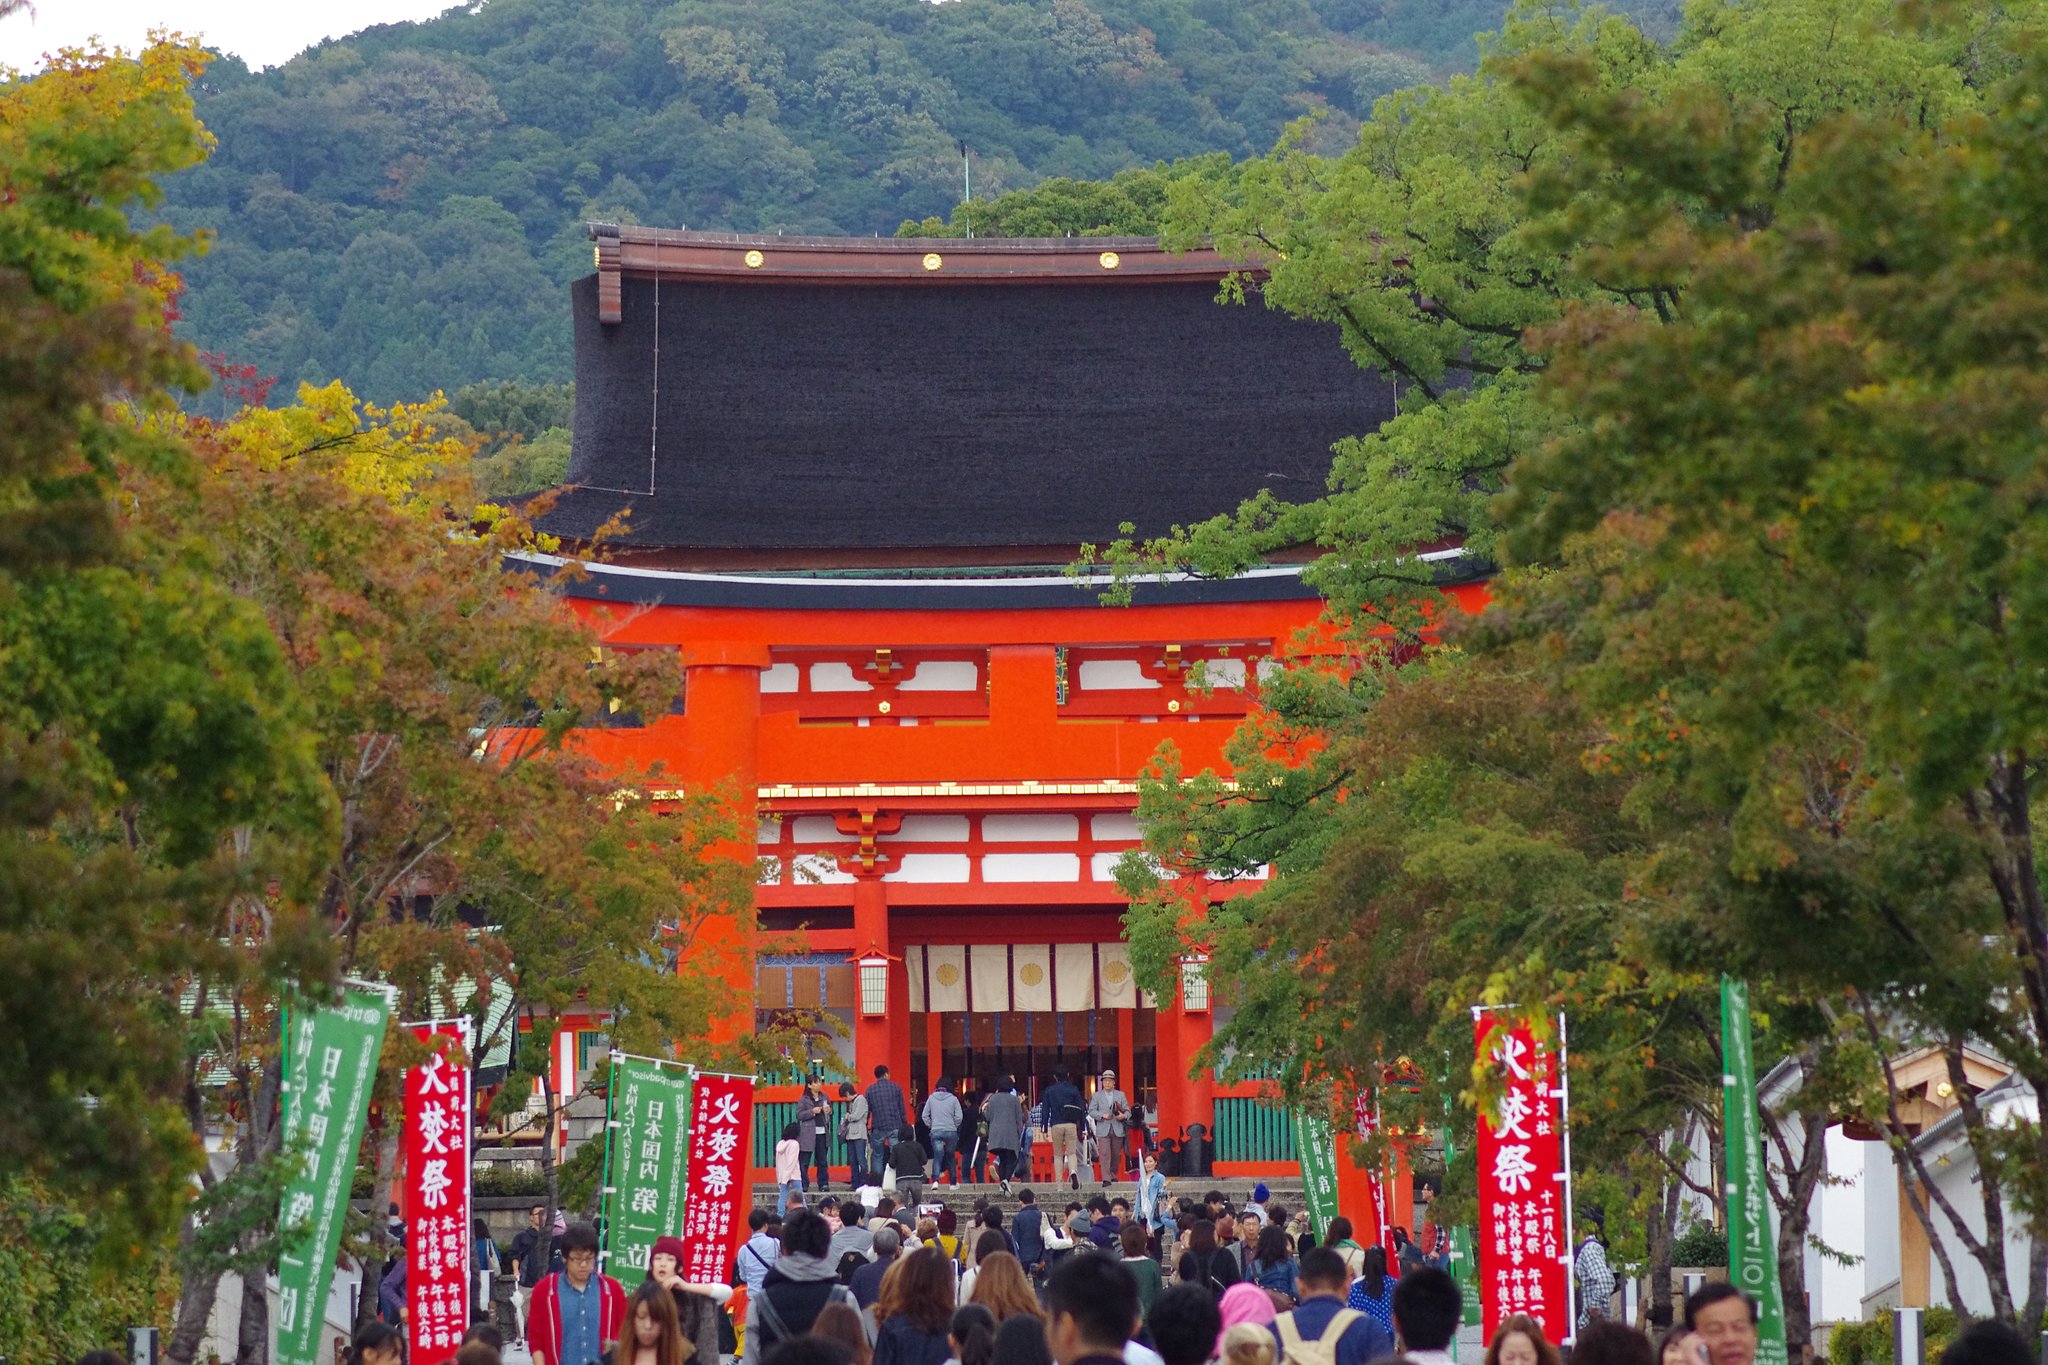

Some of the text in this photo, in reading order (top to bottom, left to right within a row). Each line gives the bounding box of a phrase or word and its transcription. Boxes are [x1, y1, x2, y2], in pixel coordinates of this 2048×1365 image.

[418, 1052, 452, 1209] 火焚祭
[441, 1215, 459, 1268] 本殿祭
[1524, 1200, 1541, 1254] 本殿祭
[1540, 1189, 1556, 1258] 十一月八日
[417, 1285, 432, 1349] 午後六時
[430, 1283, 449, 1348] 午後二時
[1496, 1269, 1511, 1324] 午後六
[1511, 1268, 1528, 1316] 午後二
